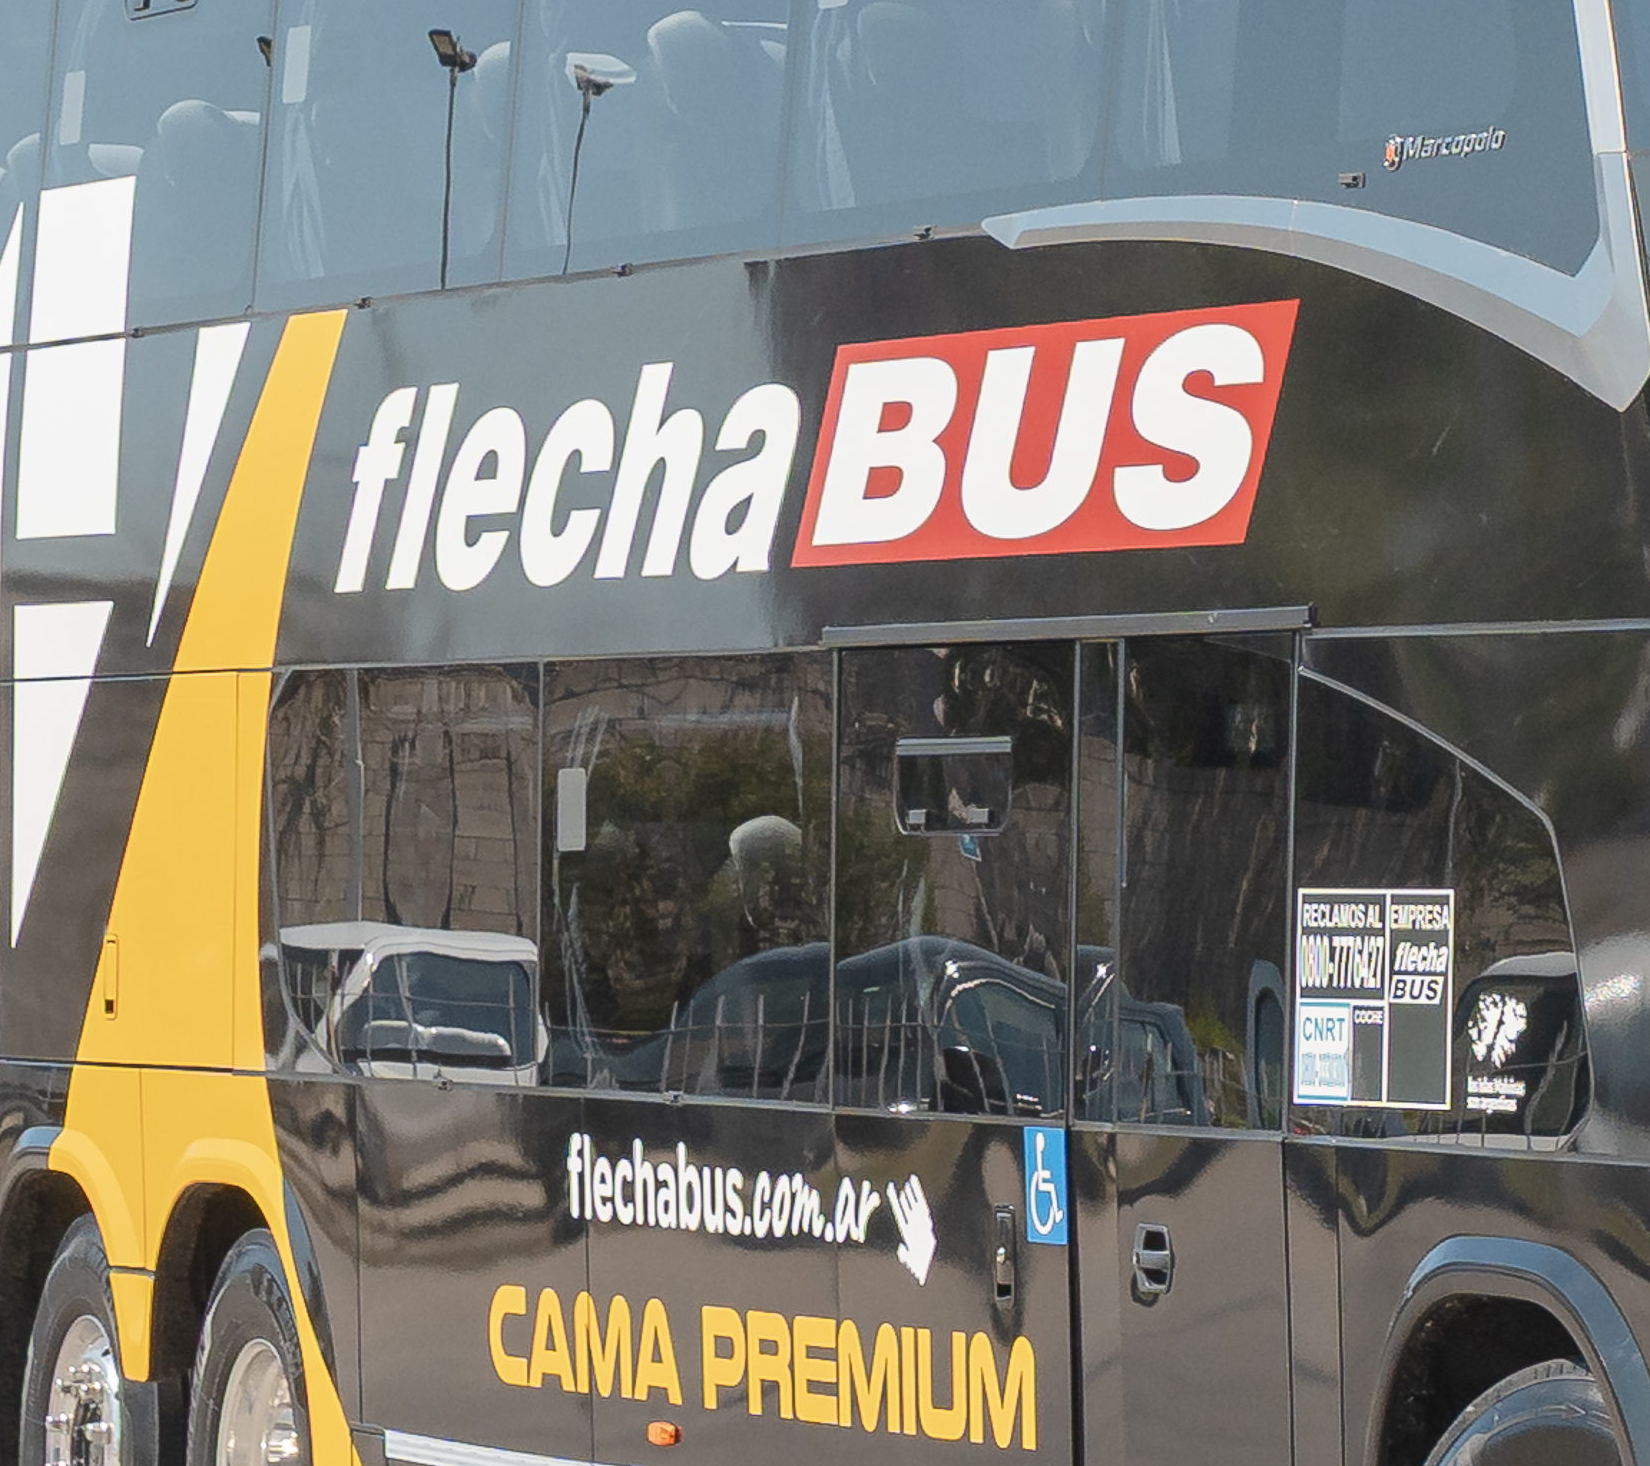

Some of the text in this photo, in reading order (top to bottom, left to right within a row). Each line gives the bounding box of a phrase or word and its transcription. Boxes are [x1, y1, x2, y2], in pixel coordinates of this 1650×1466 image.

[1403, 126, 1506, 159] Marcopolo
[333, 324, 1265, 593] flecha BUS
[1302, 903, 1383, 929] RECLAMOS AL
[1391, 904, 1449, 930] EMPRESA
[1394, 941, 1449, 973] flecha
[1392, 978, 1439, 1000] BUS
[1302, 1016, 1346, 1042] CNRT
[567, 1132, 881, 1244] flechabus.com.ar
[489, 1283, 1038, 1451] CAMA PREMIUM
